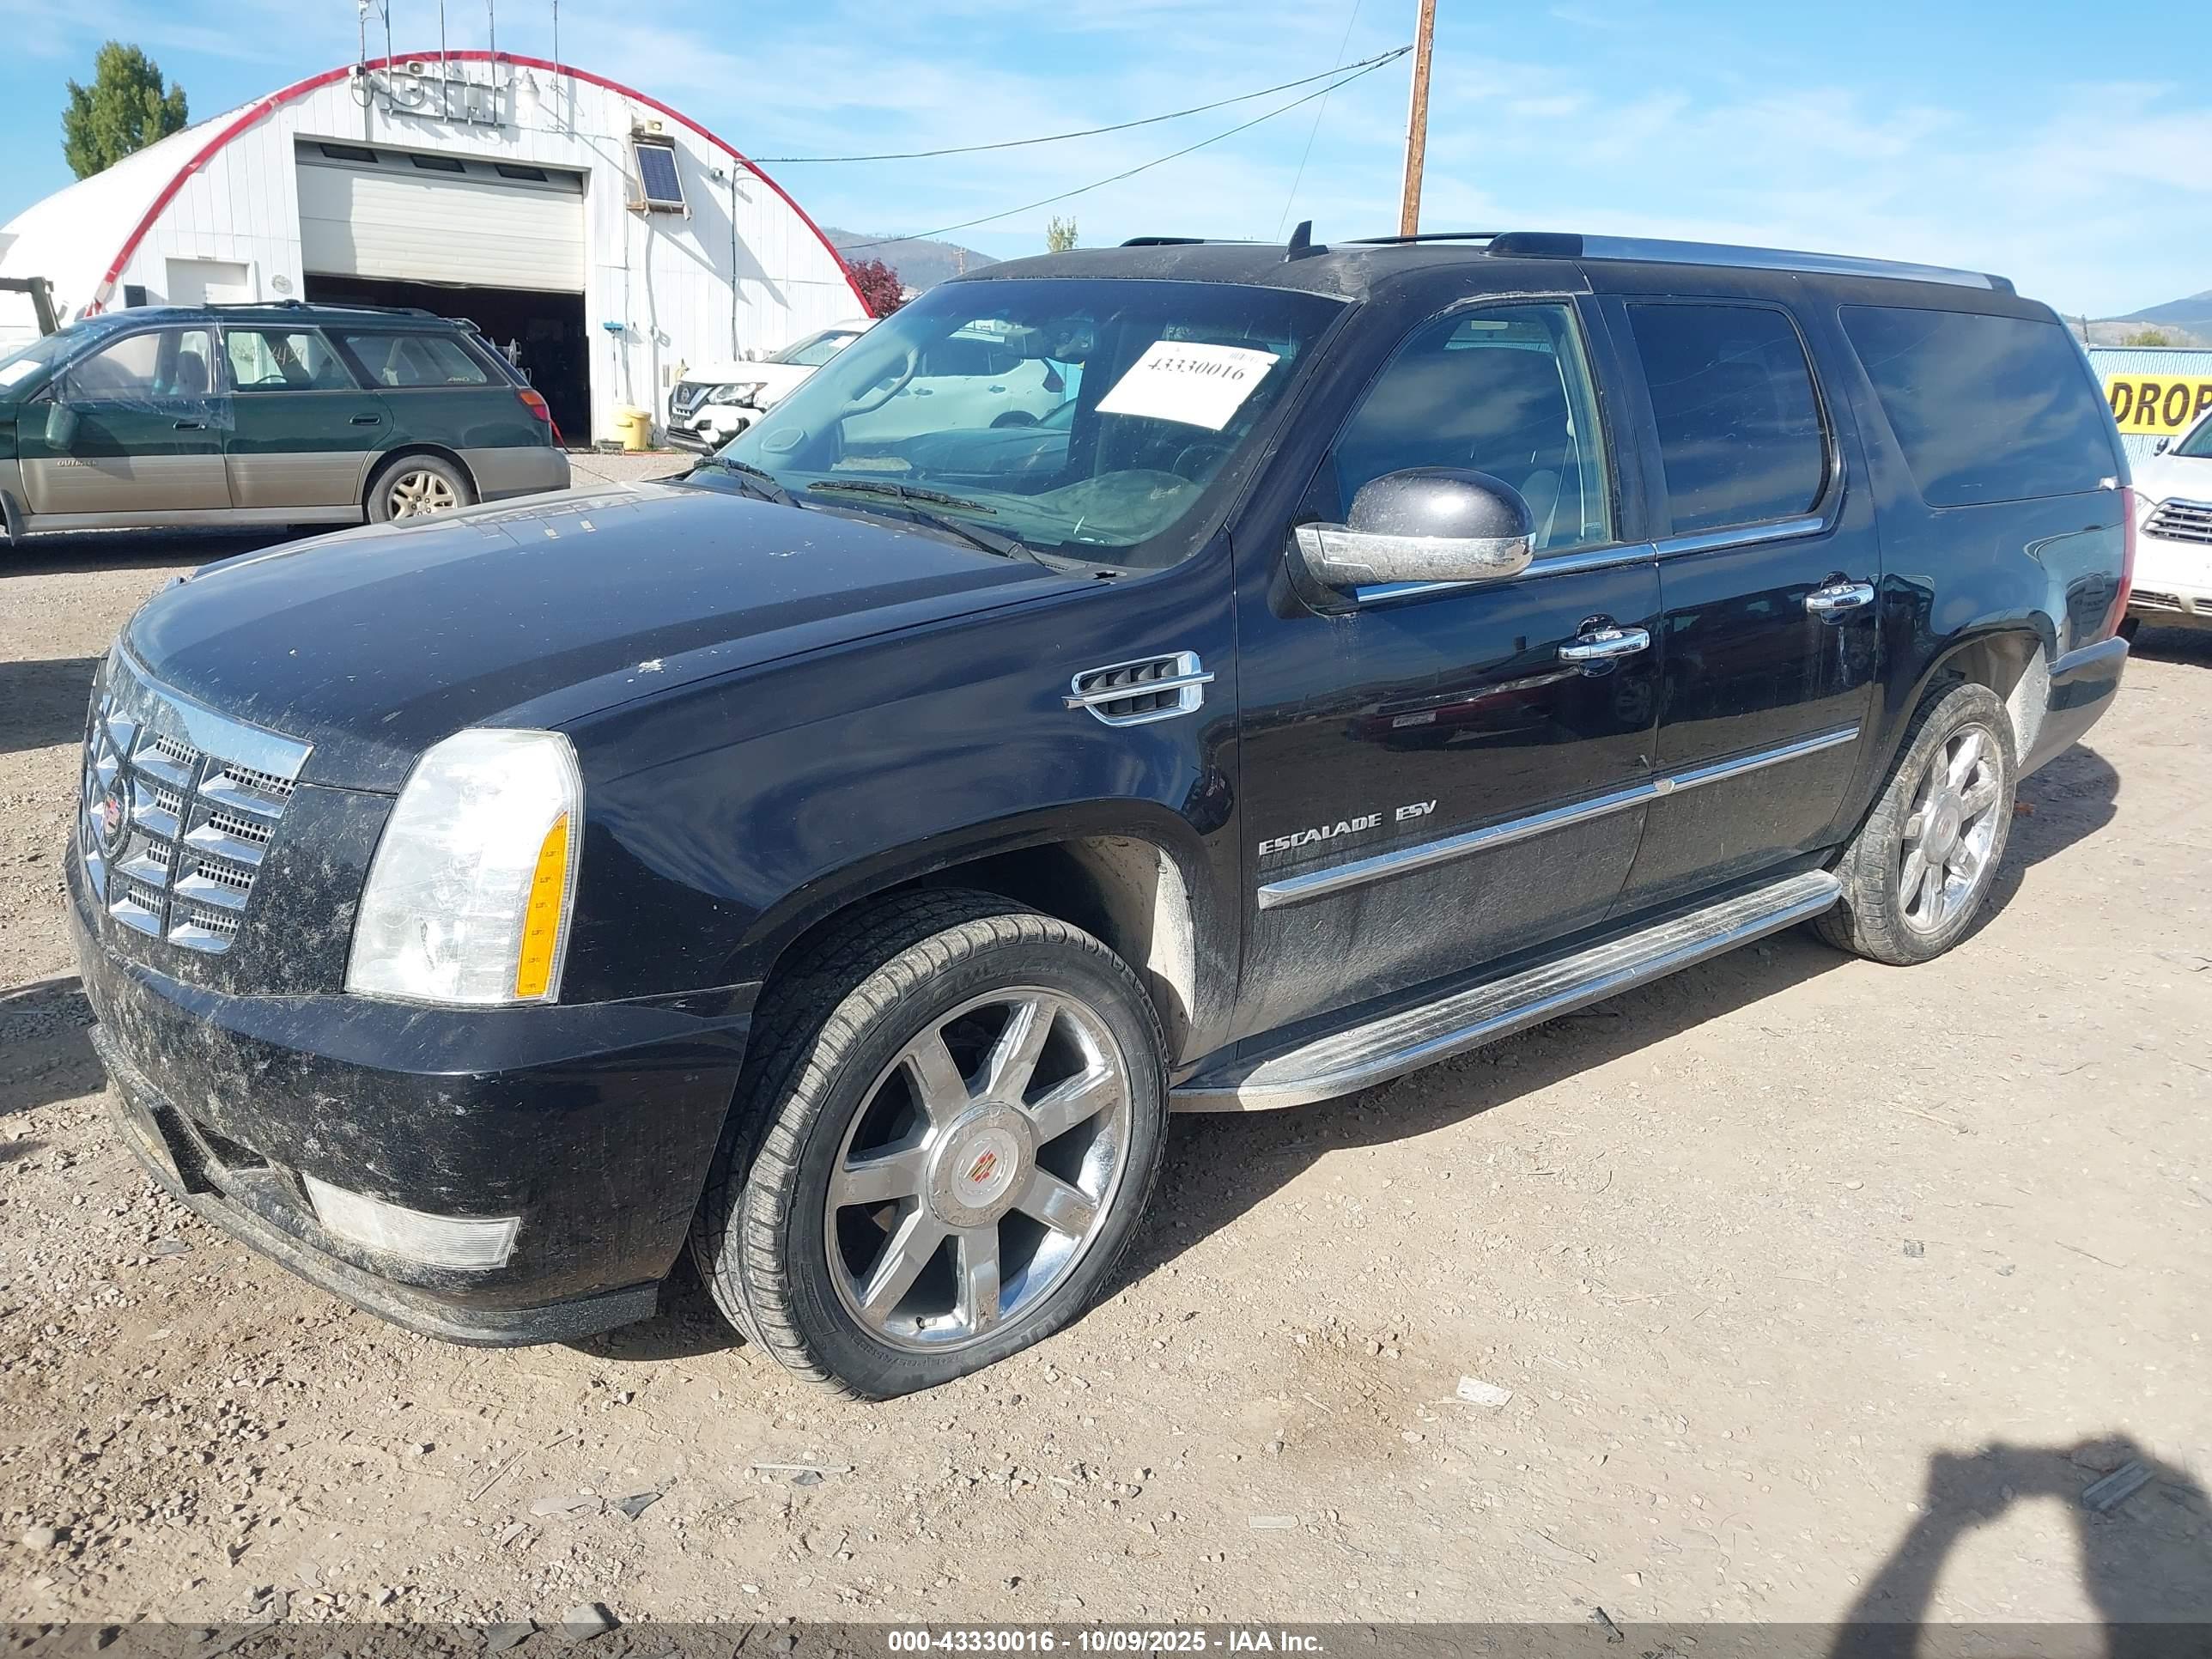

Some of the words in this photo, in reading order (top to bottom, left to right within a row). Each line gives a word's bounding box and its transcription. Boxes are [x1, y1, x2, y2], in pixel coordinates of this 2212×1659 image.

[1148, 356, 1246, 380] 43330016
[1258, 811, 1383, 856] ESCALADE
[1395, 799, 1437, 822] ESV
